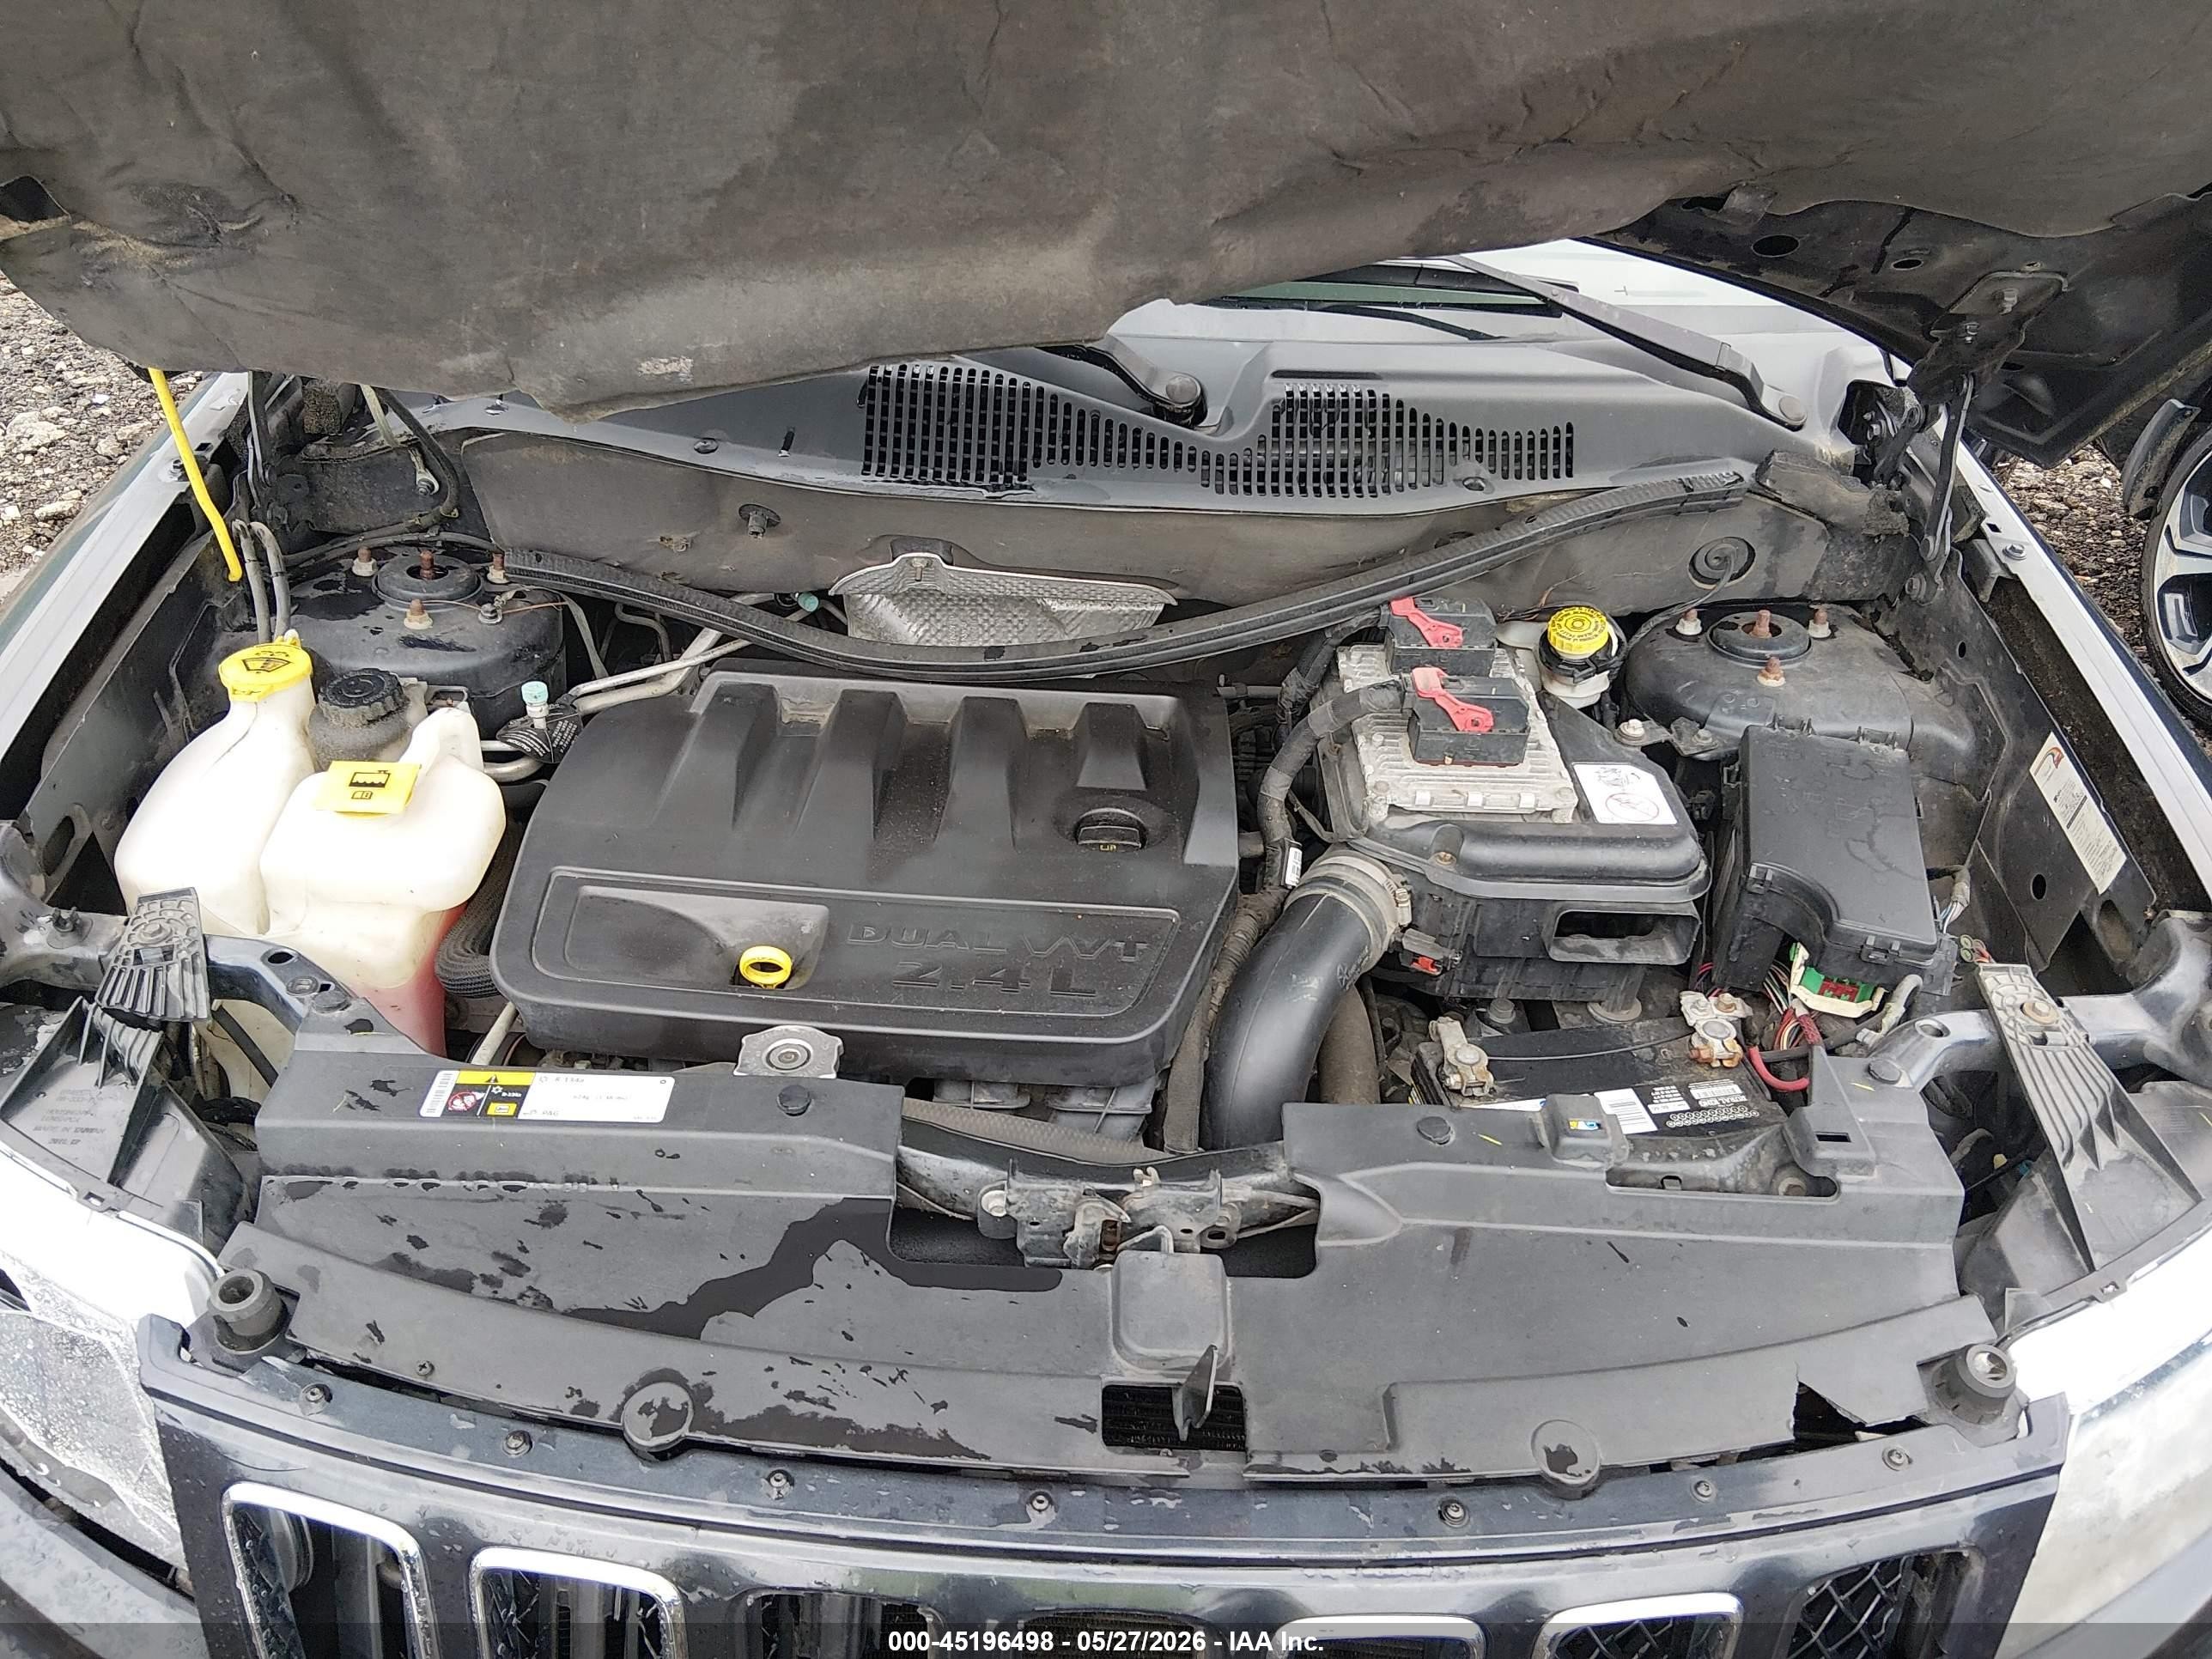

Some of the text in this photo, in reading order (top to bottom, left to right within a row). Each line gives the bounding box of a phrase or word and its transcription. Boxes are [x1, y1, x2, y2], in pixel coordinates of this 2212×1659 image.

[847, 922, 1150, 963] DUAL VVT
[891, 961, 1097, 998] 2.4L
